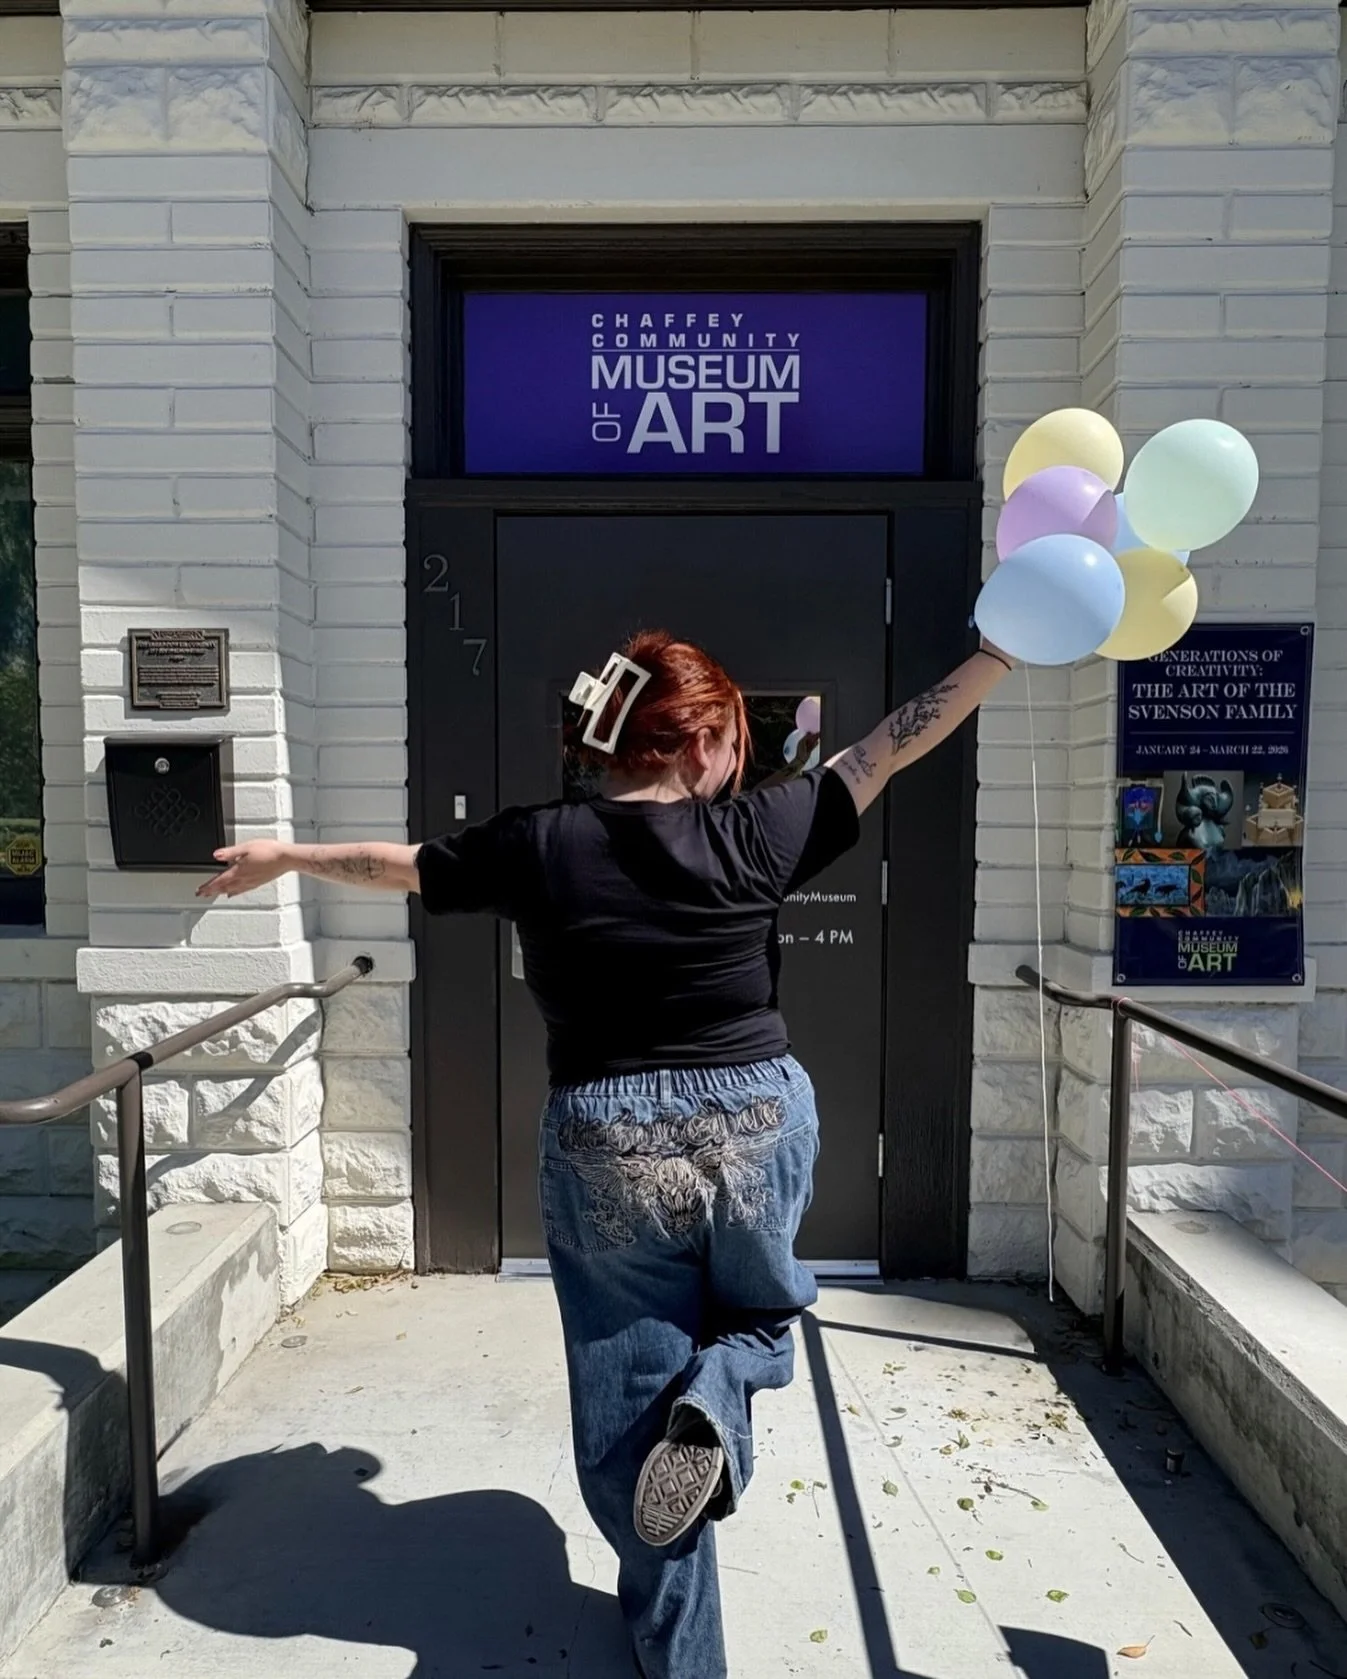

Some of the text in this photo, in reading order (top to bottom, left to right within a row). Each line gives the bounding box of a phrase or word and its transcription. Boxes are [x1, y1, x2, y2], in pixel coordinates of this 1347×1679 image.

[591, 313, 743, 327] CHAFFEY
[592, 333, 800, 348] COMMUNITY
[591, 355, 800, 389] MUSEUM
[592, 402, 621, 442] OF
[626, 392, 800, 453] ART
[1262, 650, 1283, 662] OF
[1165, 664, 1264, 677] CREATIVITY:
[1132, 683, 1296, 699] THE ART OF THE
[1128, 704, 1298, 720] SVENSON FAMILY
[1136, 744, 1188, 755] JANUARY
[815, 929, 825, 944] 4
[830, 929, 854, 944] PM
[1178, 942, 1238, 953] MUSEUM
[1187, 953, 1237, 972] ART
